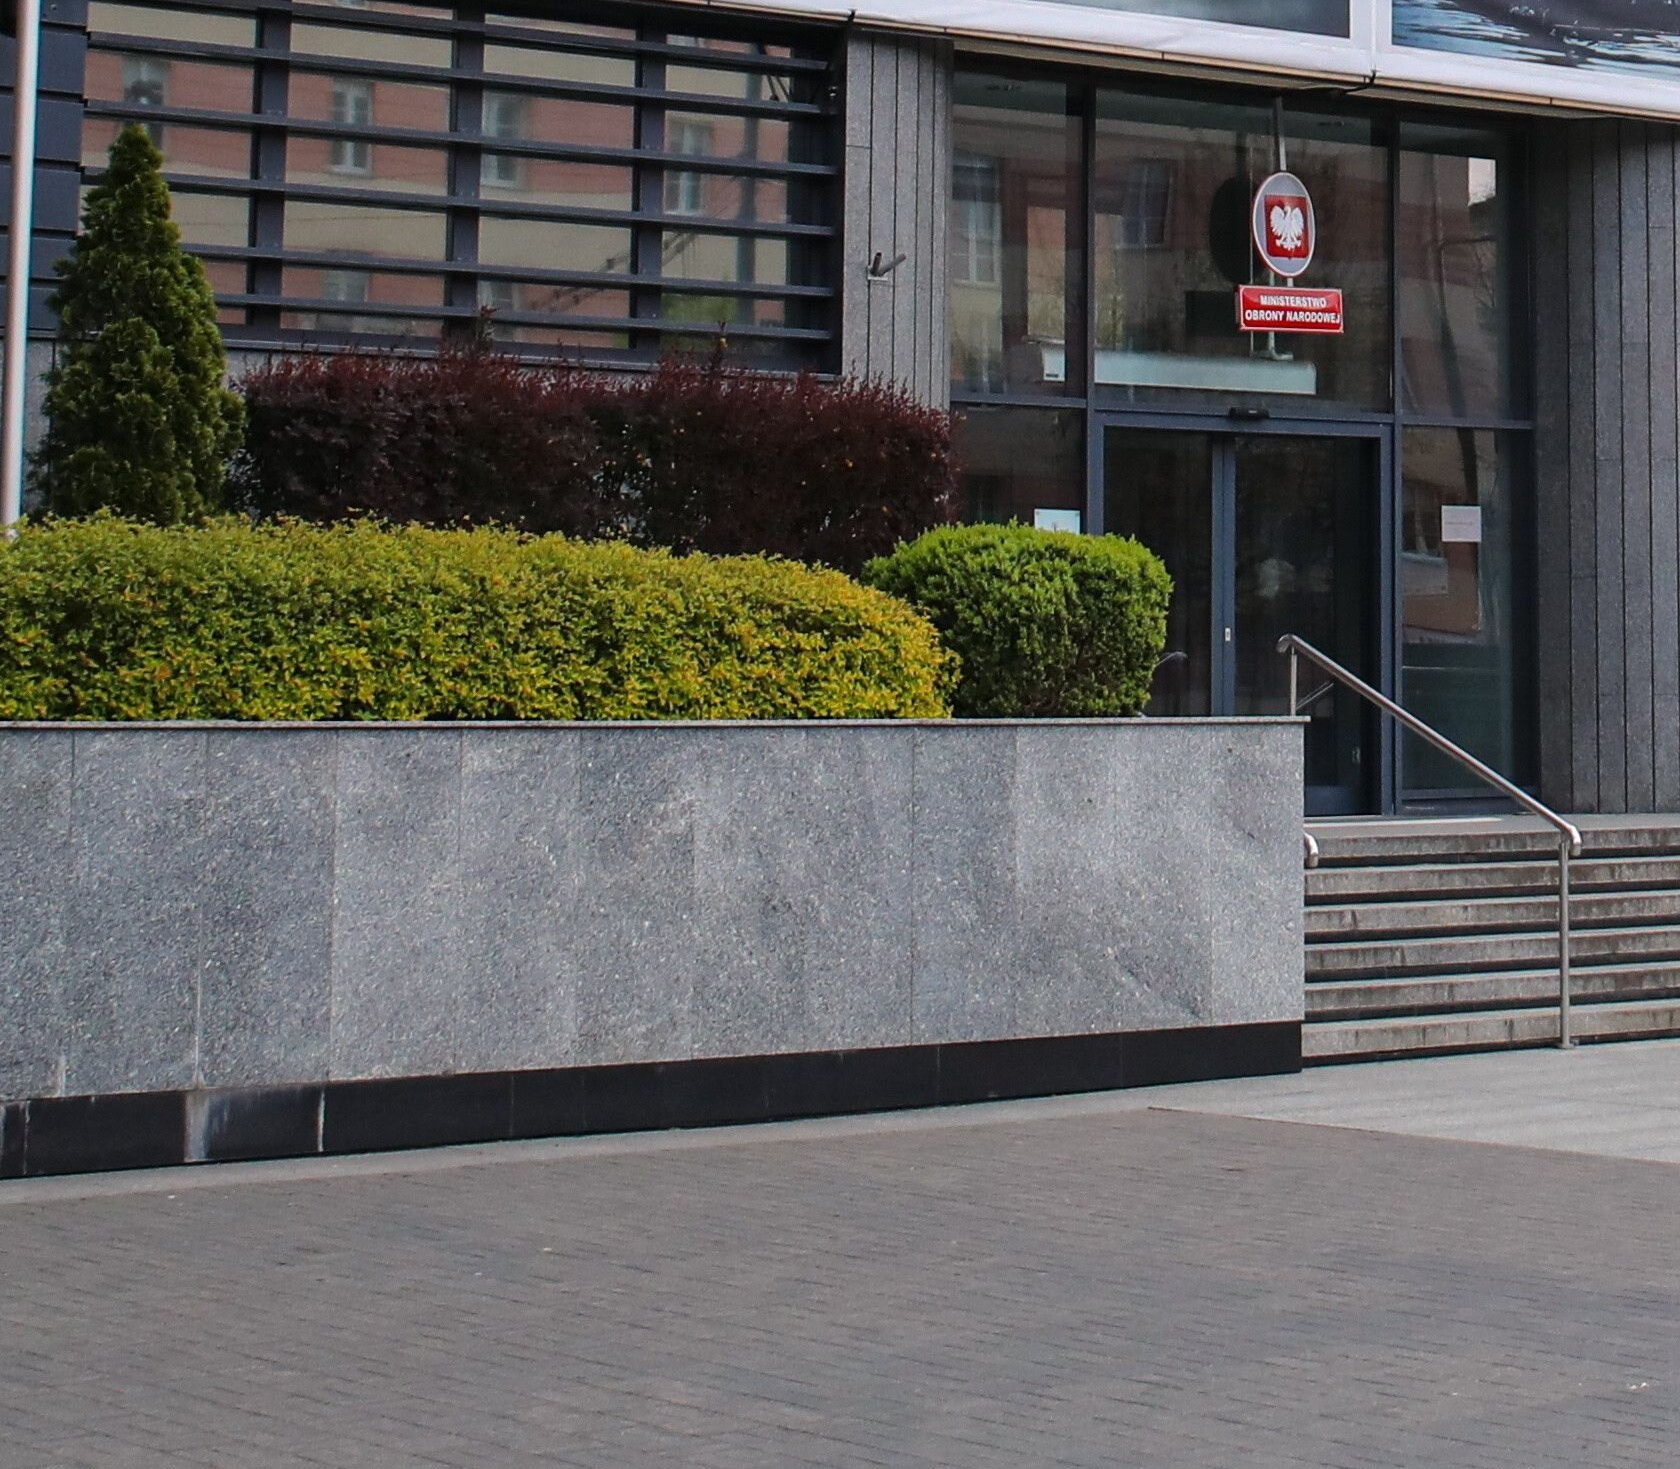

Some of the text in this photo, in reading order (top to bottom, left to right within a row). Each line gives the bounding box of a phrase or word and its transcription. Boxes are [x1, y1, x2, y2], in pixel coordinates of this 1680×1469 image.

[1260, 295, 1327, 308] MINISTERSTWO
[1245, 310, 1341, 324] OBRONY NARODOWEJ
